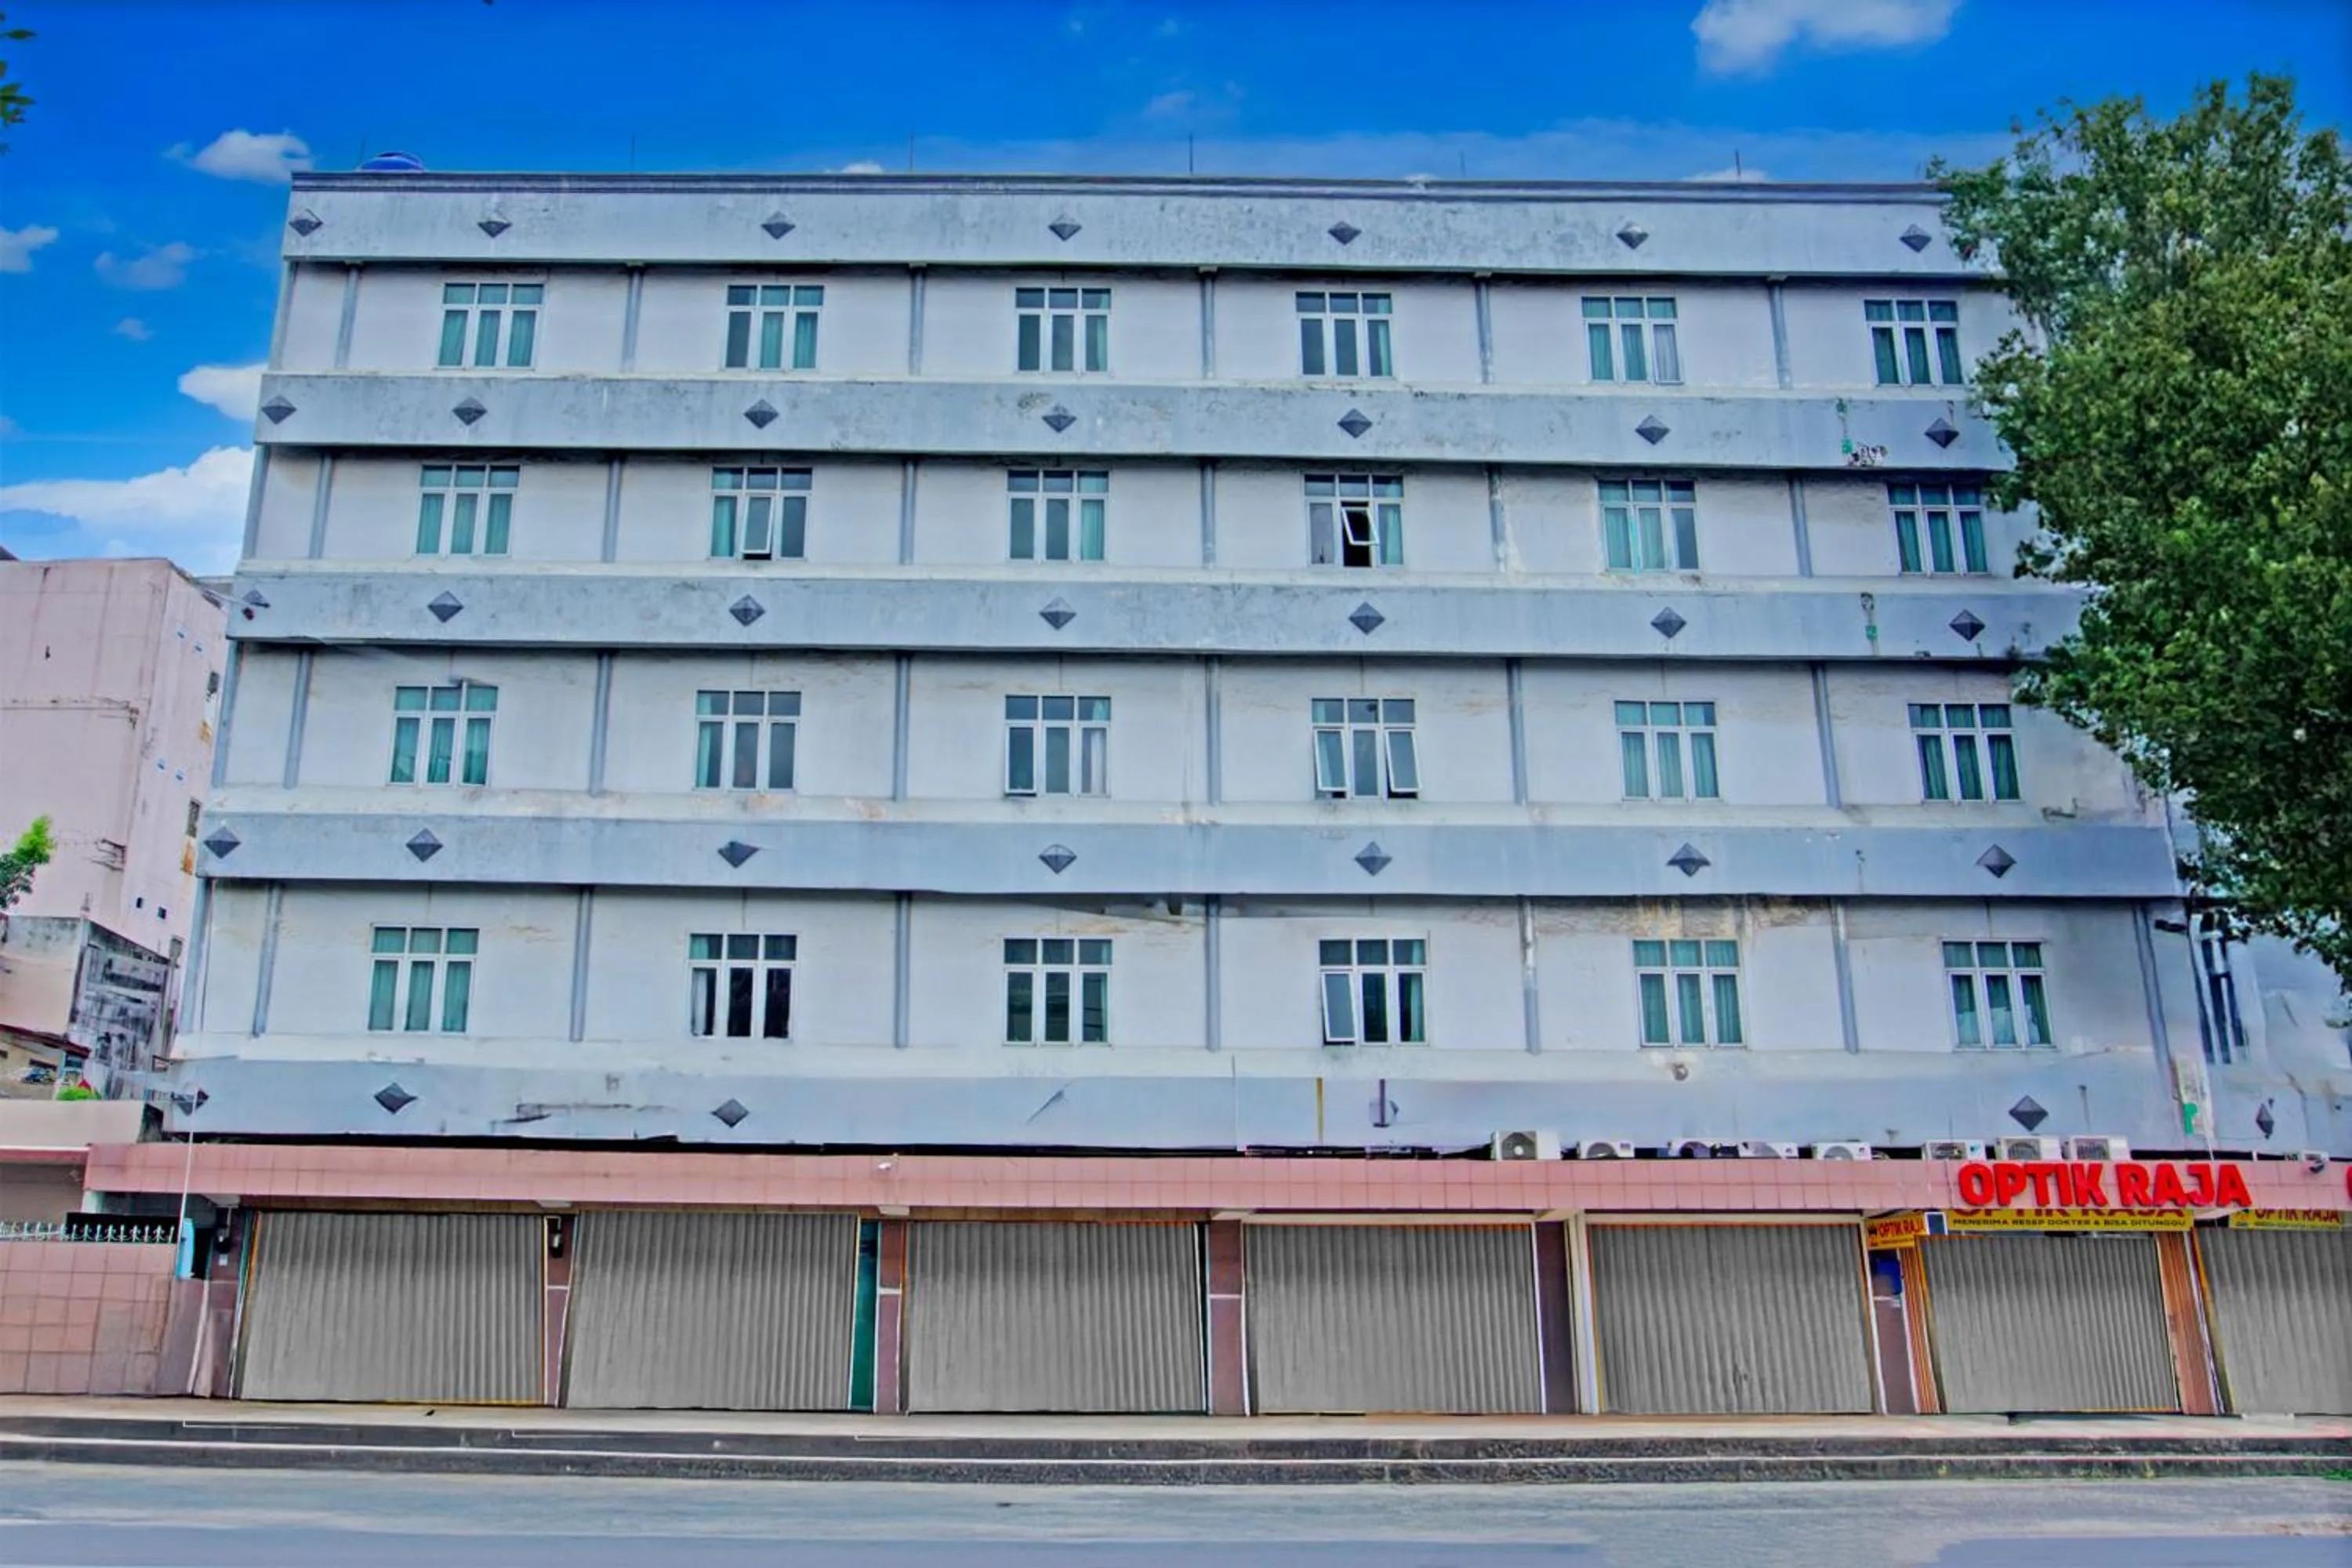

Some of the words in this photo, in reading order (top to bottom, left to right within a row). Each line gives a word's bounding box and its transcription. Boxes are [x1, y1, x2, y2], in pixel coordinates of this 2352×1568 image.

[1958, 1163, 2108, 1206] OPTIK
[2114, 1163, 2252, 1207] RAJA
[1878, 1221, 1902, 1237] OPTIK
[2130, 1218, 2187, 1227] DITUNGGU
